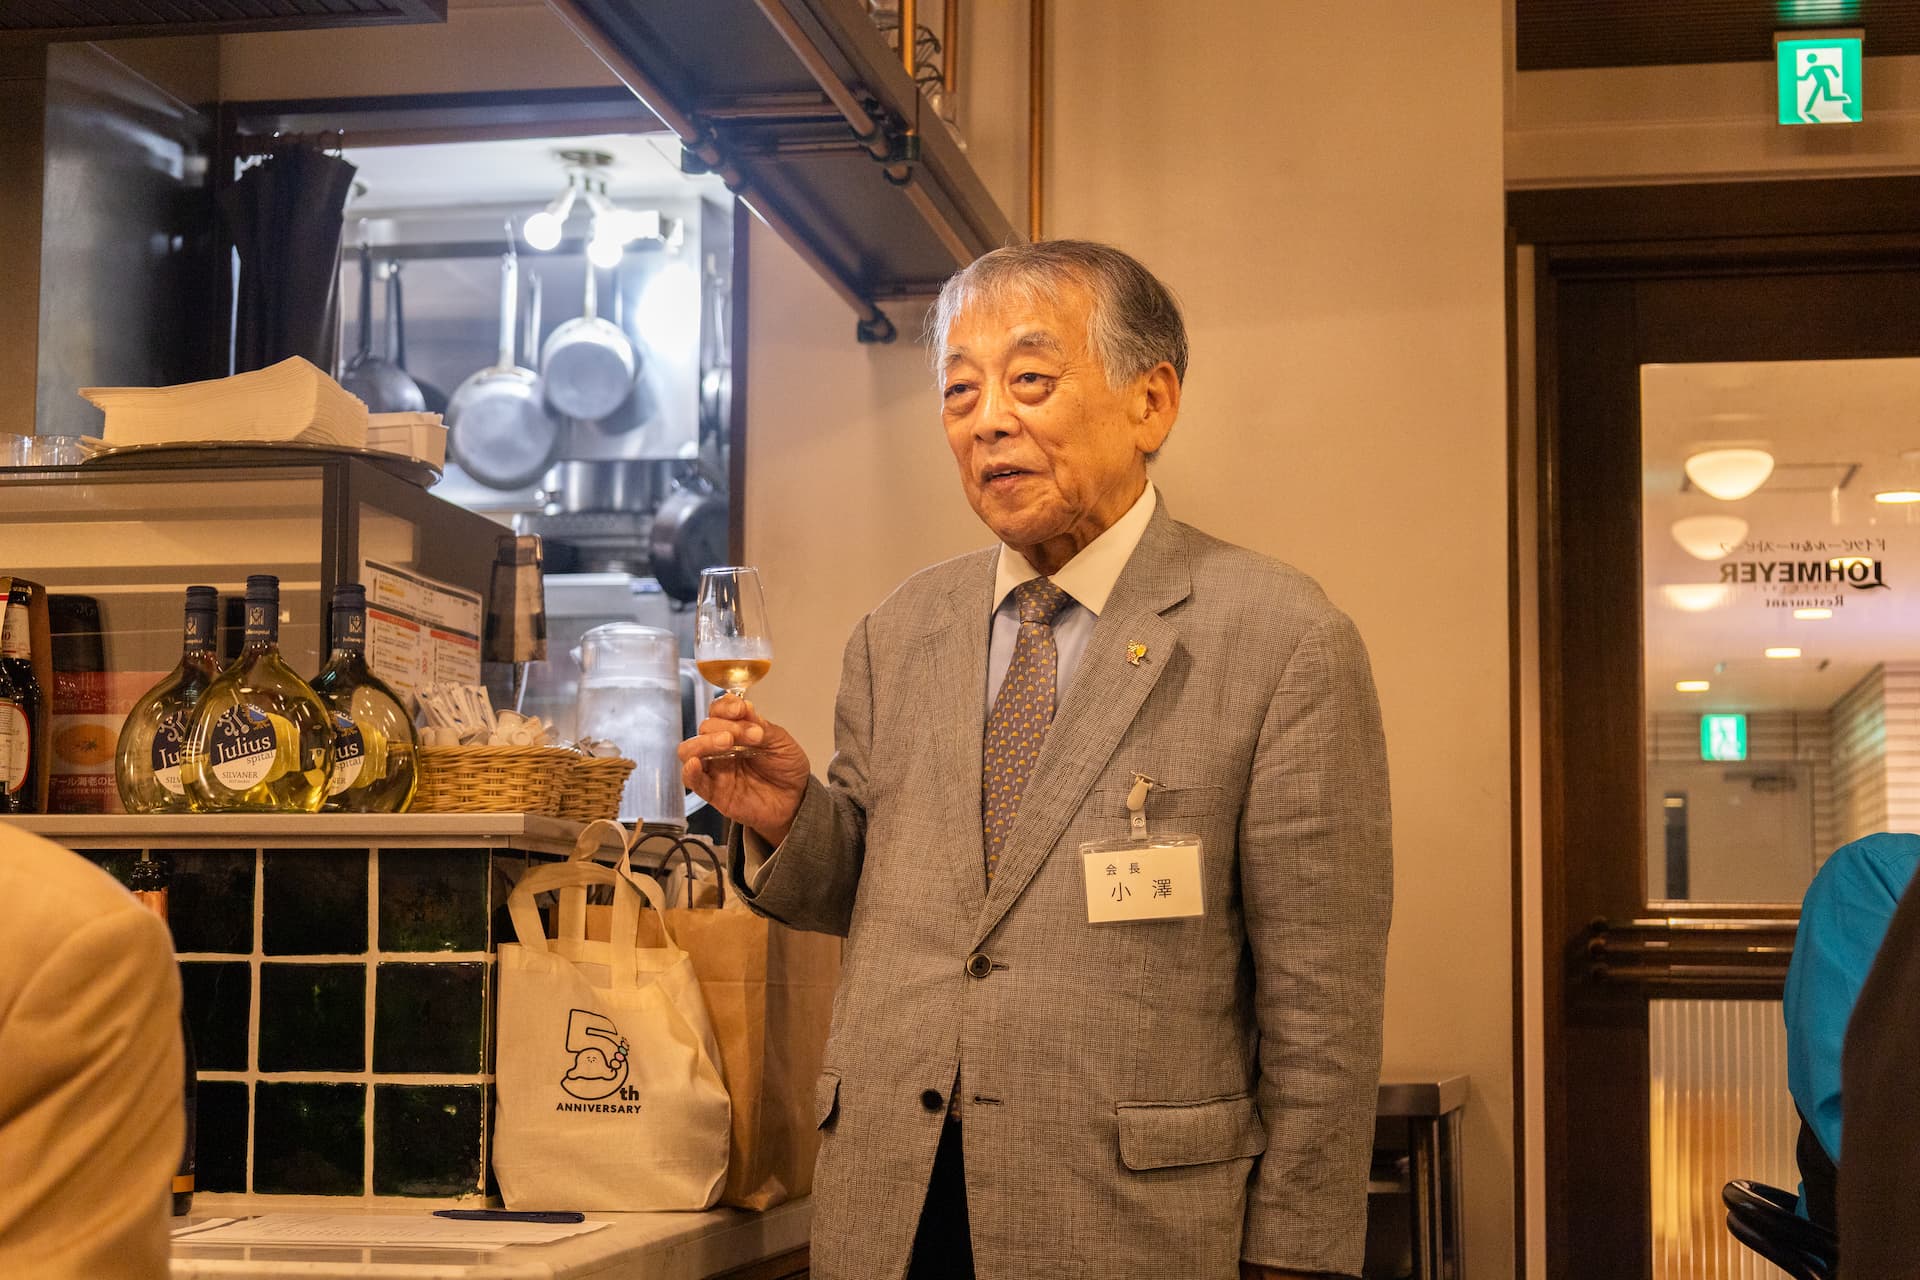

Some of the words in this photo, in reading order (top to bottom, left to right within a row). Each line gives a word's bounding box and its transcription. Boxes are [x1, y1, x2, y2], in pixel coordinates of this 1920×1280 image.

[217, 735, 272, 764] Julius
[246, 751, 274, 767] spital
[222, 771, 259, 780] SILVANER
[1105, 862, 1141, 876] 会長
[1111, 878, 1173, 903] 小澤
[556, 1103, 642, 1114] ANNIVERSARY
